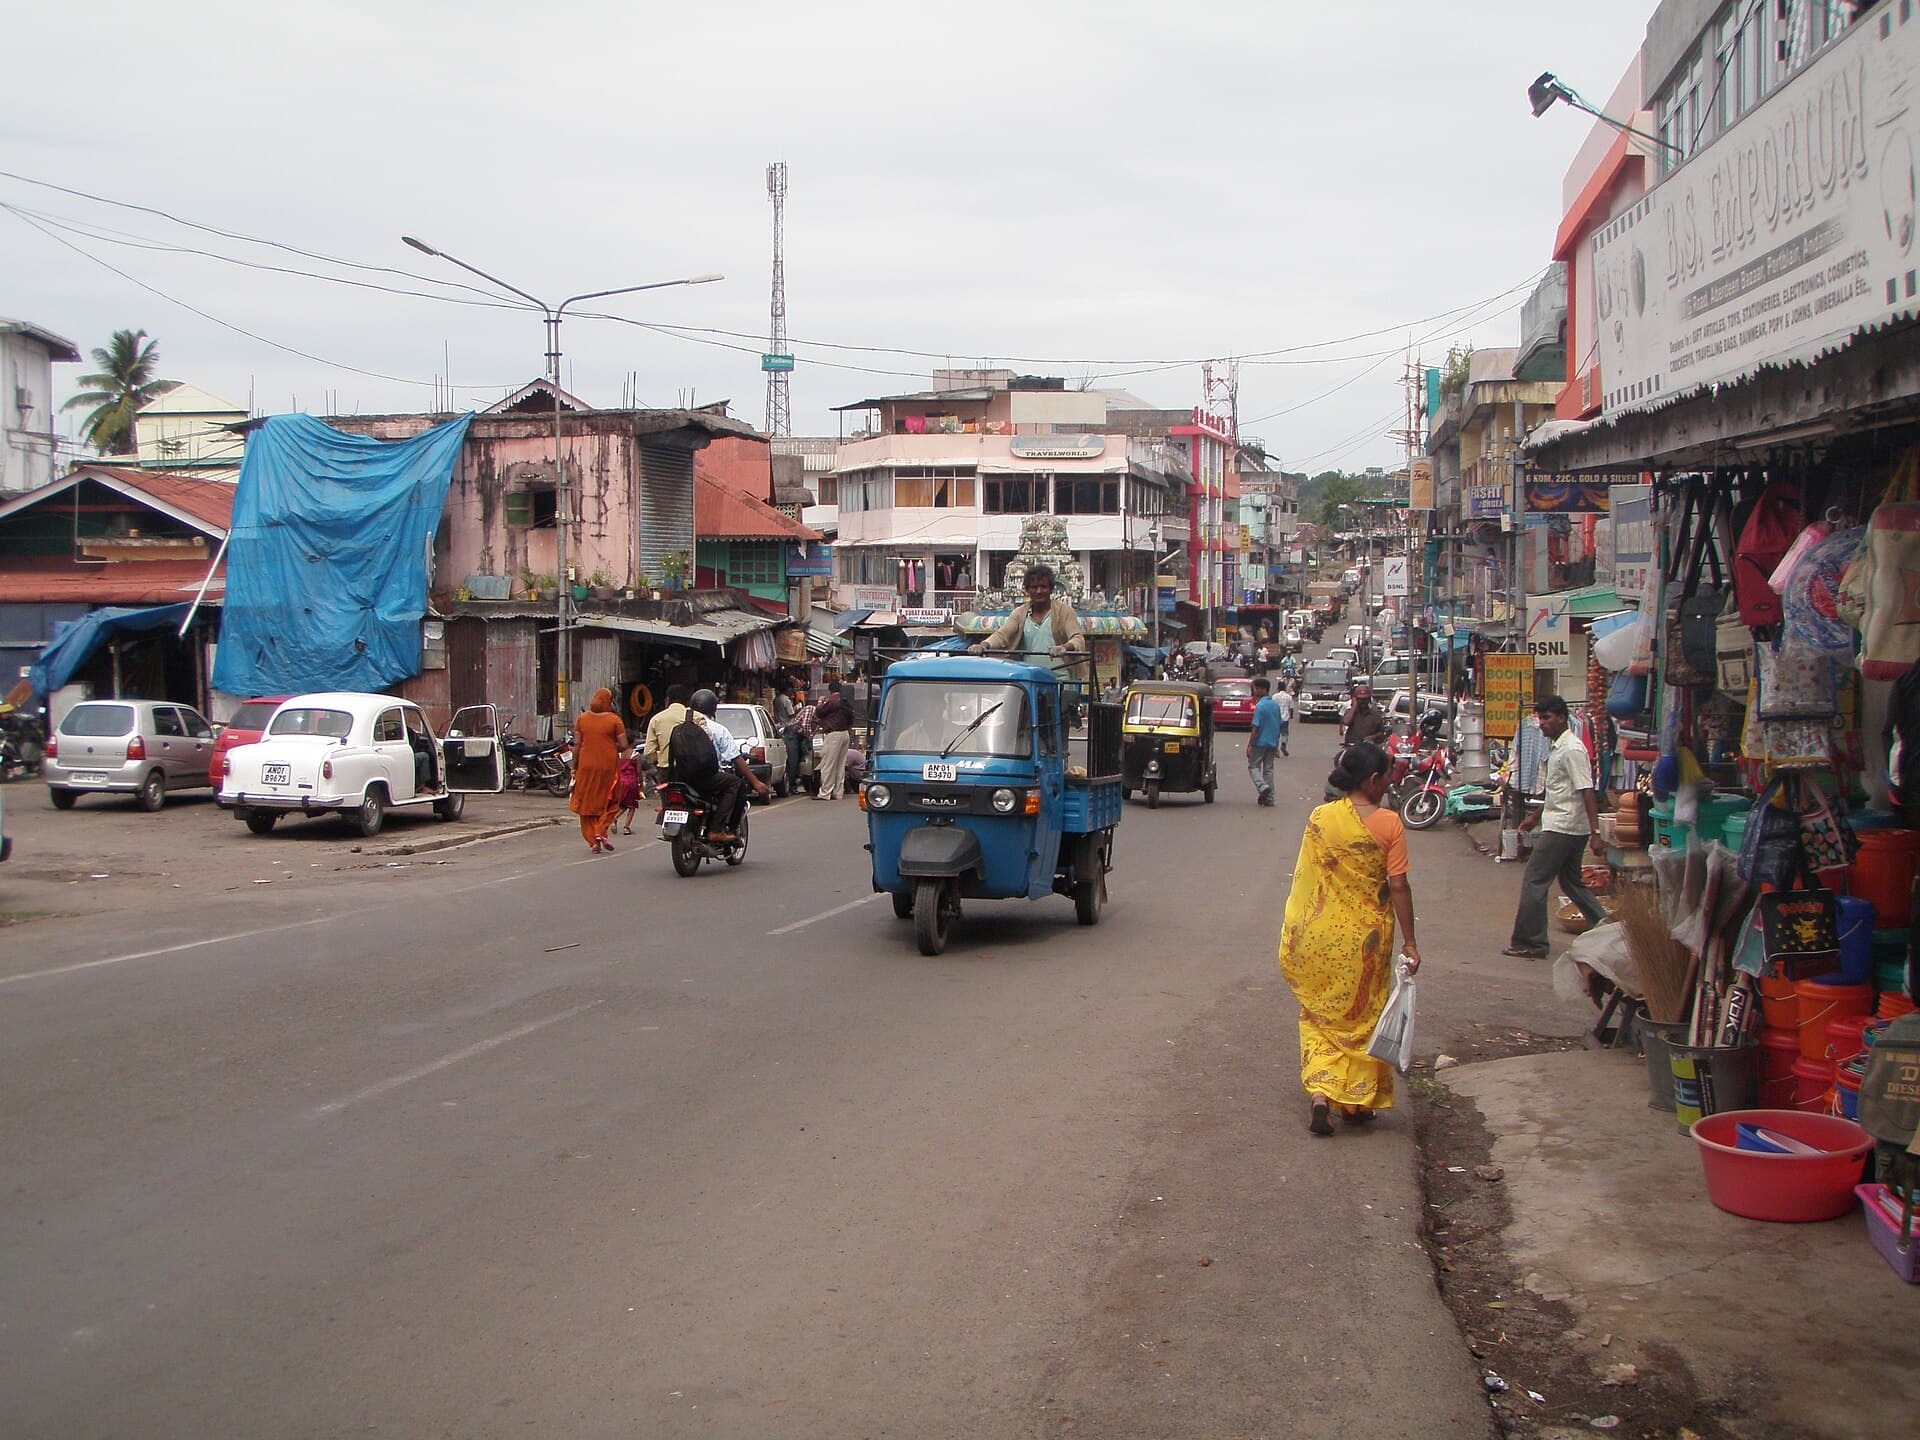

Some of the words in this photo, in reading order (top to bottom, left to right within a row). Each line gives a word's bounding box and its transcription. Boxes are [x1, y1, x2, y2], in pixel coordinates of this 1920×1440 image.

[1708, 53, 1868, 264] EMPORIUM
[1579, 474, 1600, 483] GOLD
[1610, 474, 1637, 483] SILVER
[1527, 641, 1568, 656] BSNL
[922, 798, 957, 806] BAJAJ
